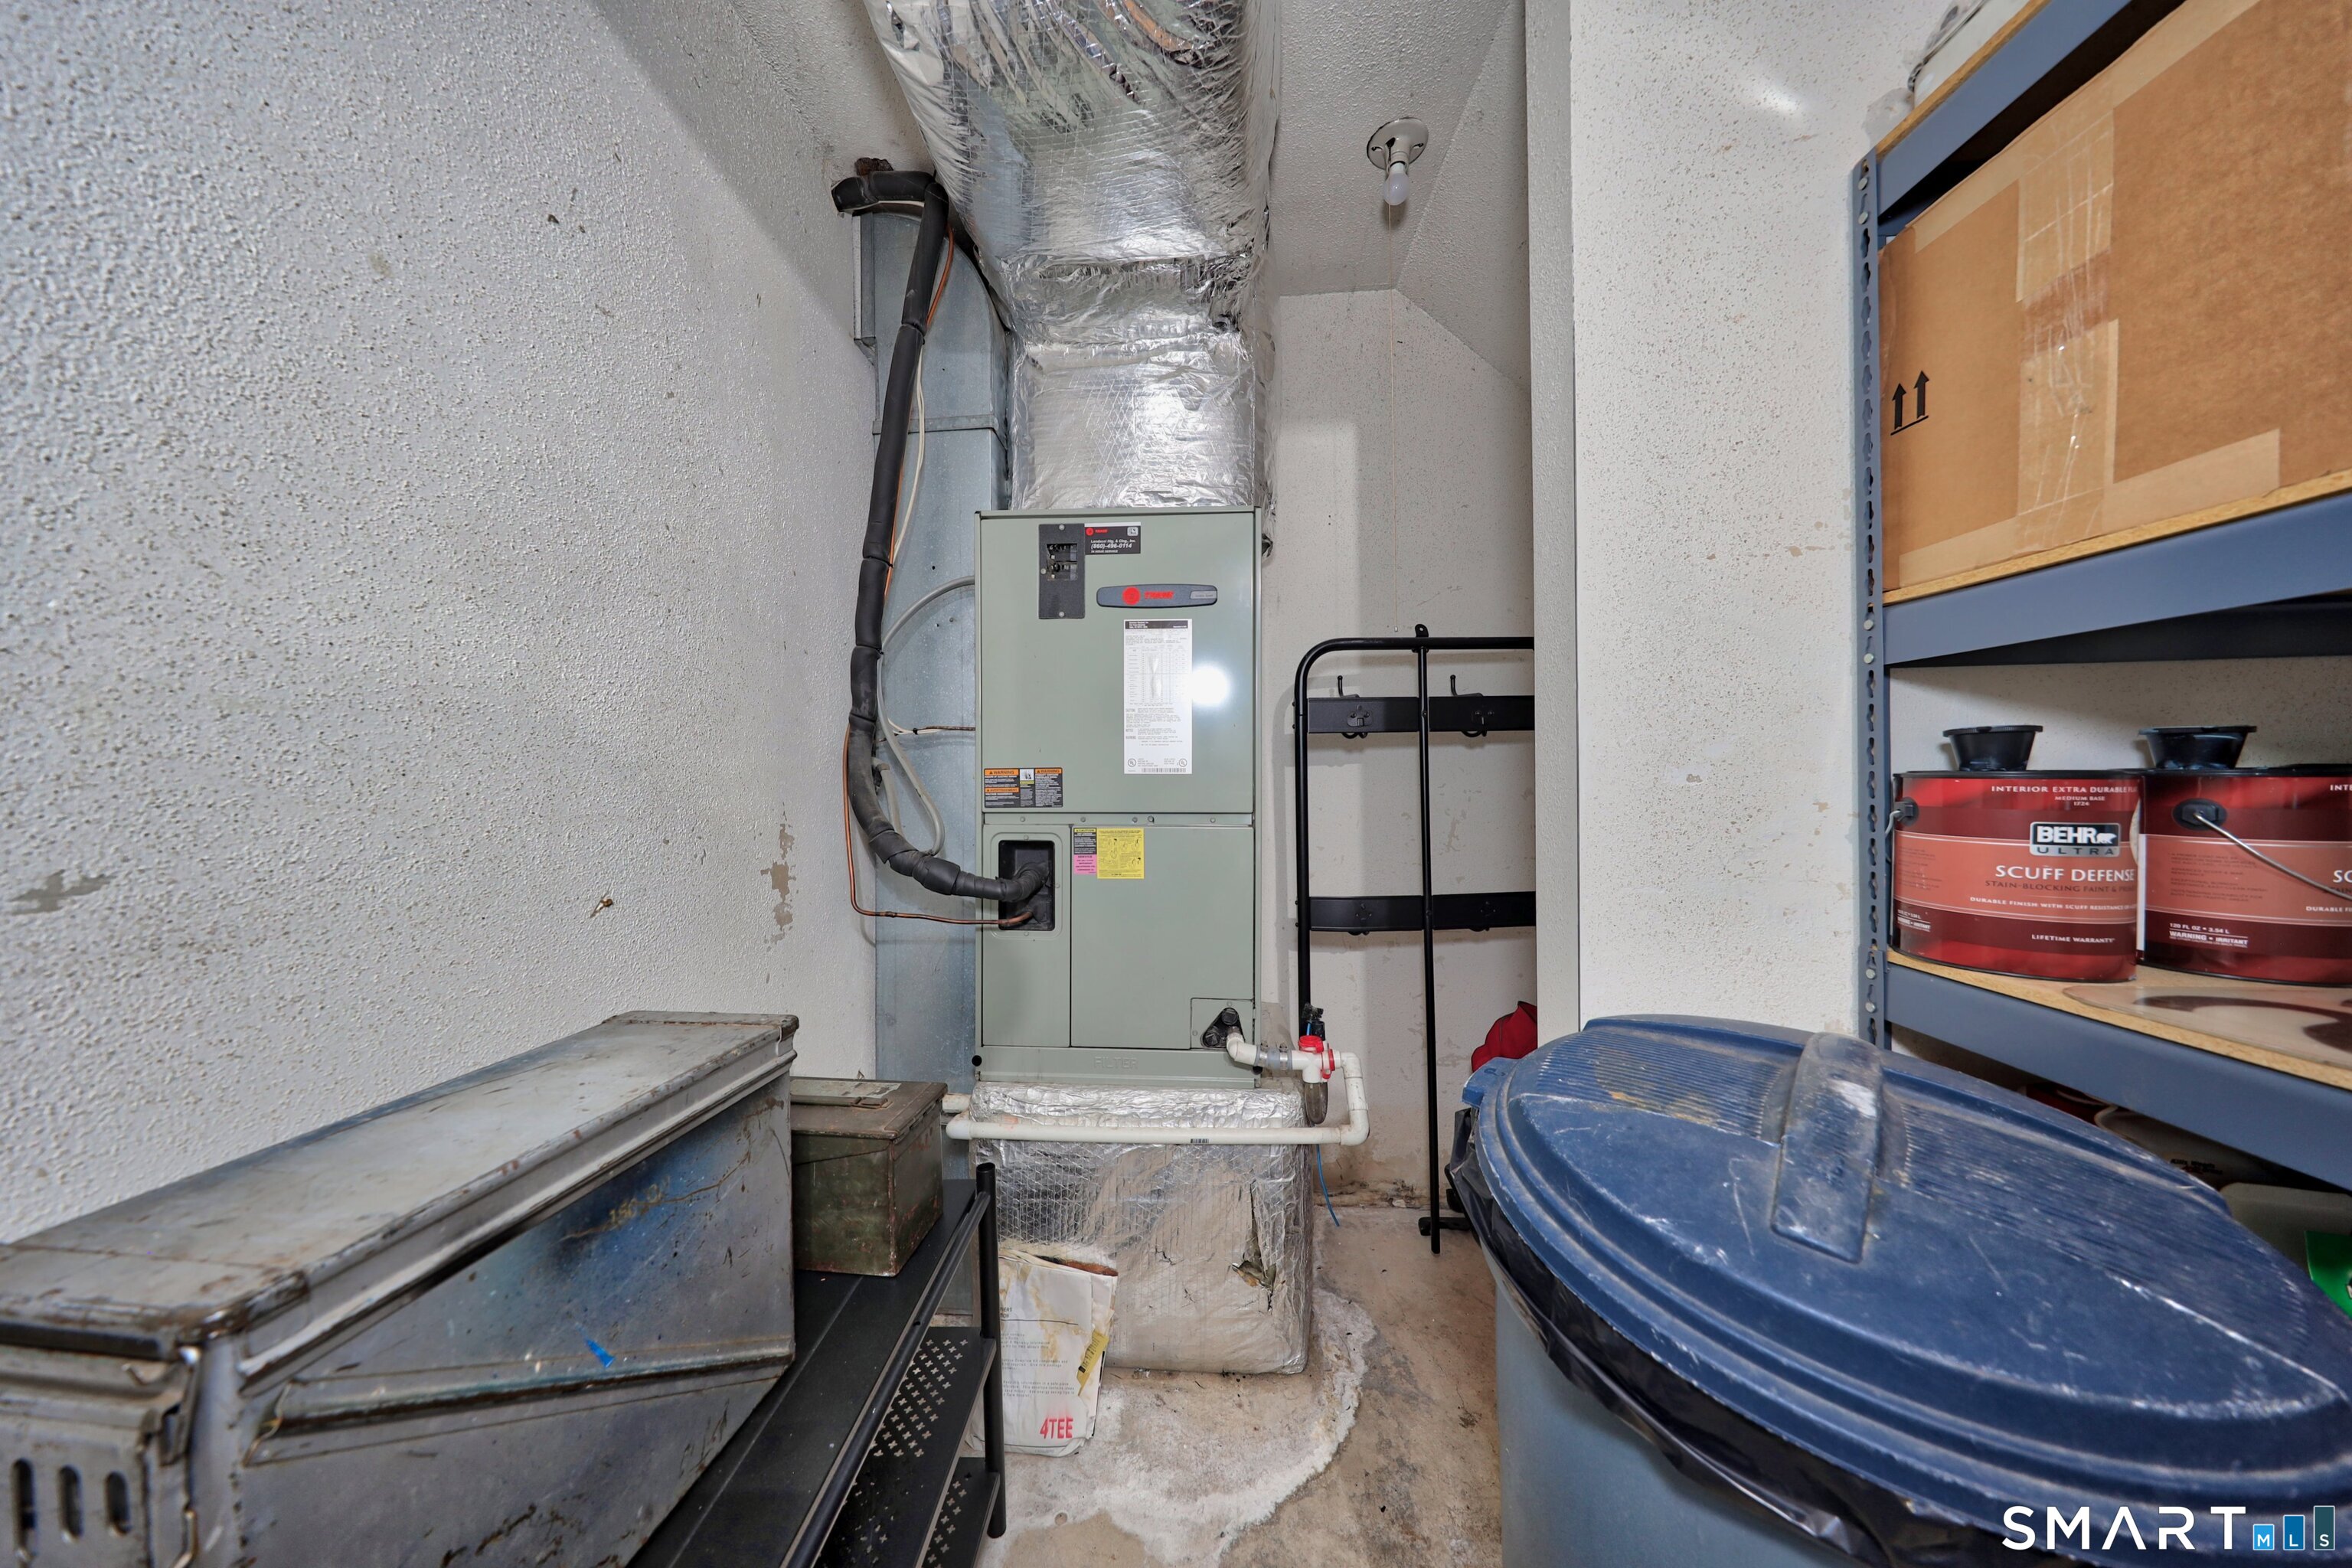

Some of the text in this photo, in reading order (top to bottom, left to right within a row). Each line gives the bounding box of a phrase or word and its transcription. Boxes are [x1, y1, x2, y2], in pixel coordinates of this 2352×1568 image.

[2037, 826, 2097, 844] BEHR
[2037, 847, 2114, 855] ULTRA
[1995, 865, 2135, 882] SCUFF DEFENSE
[1985, 880, 2080, 892] STAIN-BLOCKING
[1970, 897, 2007, 905] DURABLE
[2031, 934, 2070, 942] LIFETIME
[2169, 930, 2207, 941] WARNING
[1093, 1057, 1138, 1070] FILTER
[1040, 1417, 1073, 1439] 4TEE
